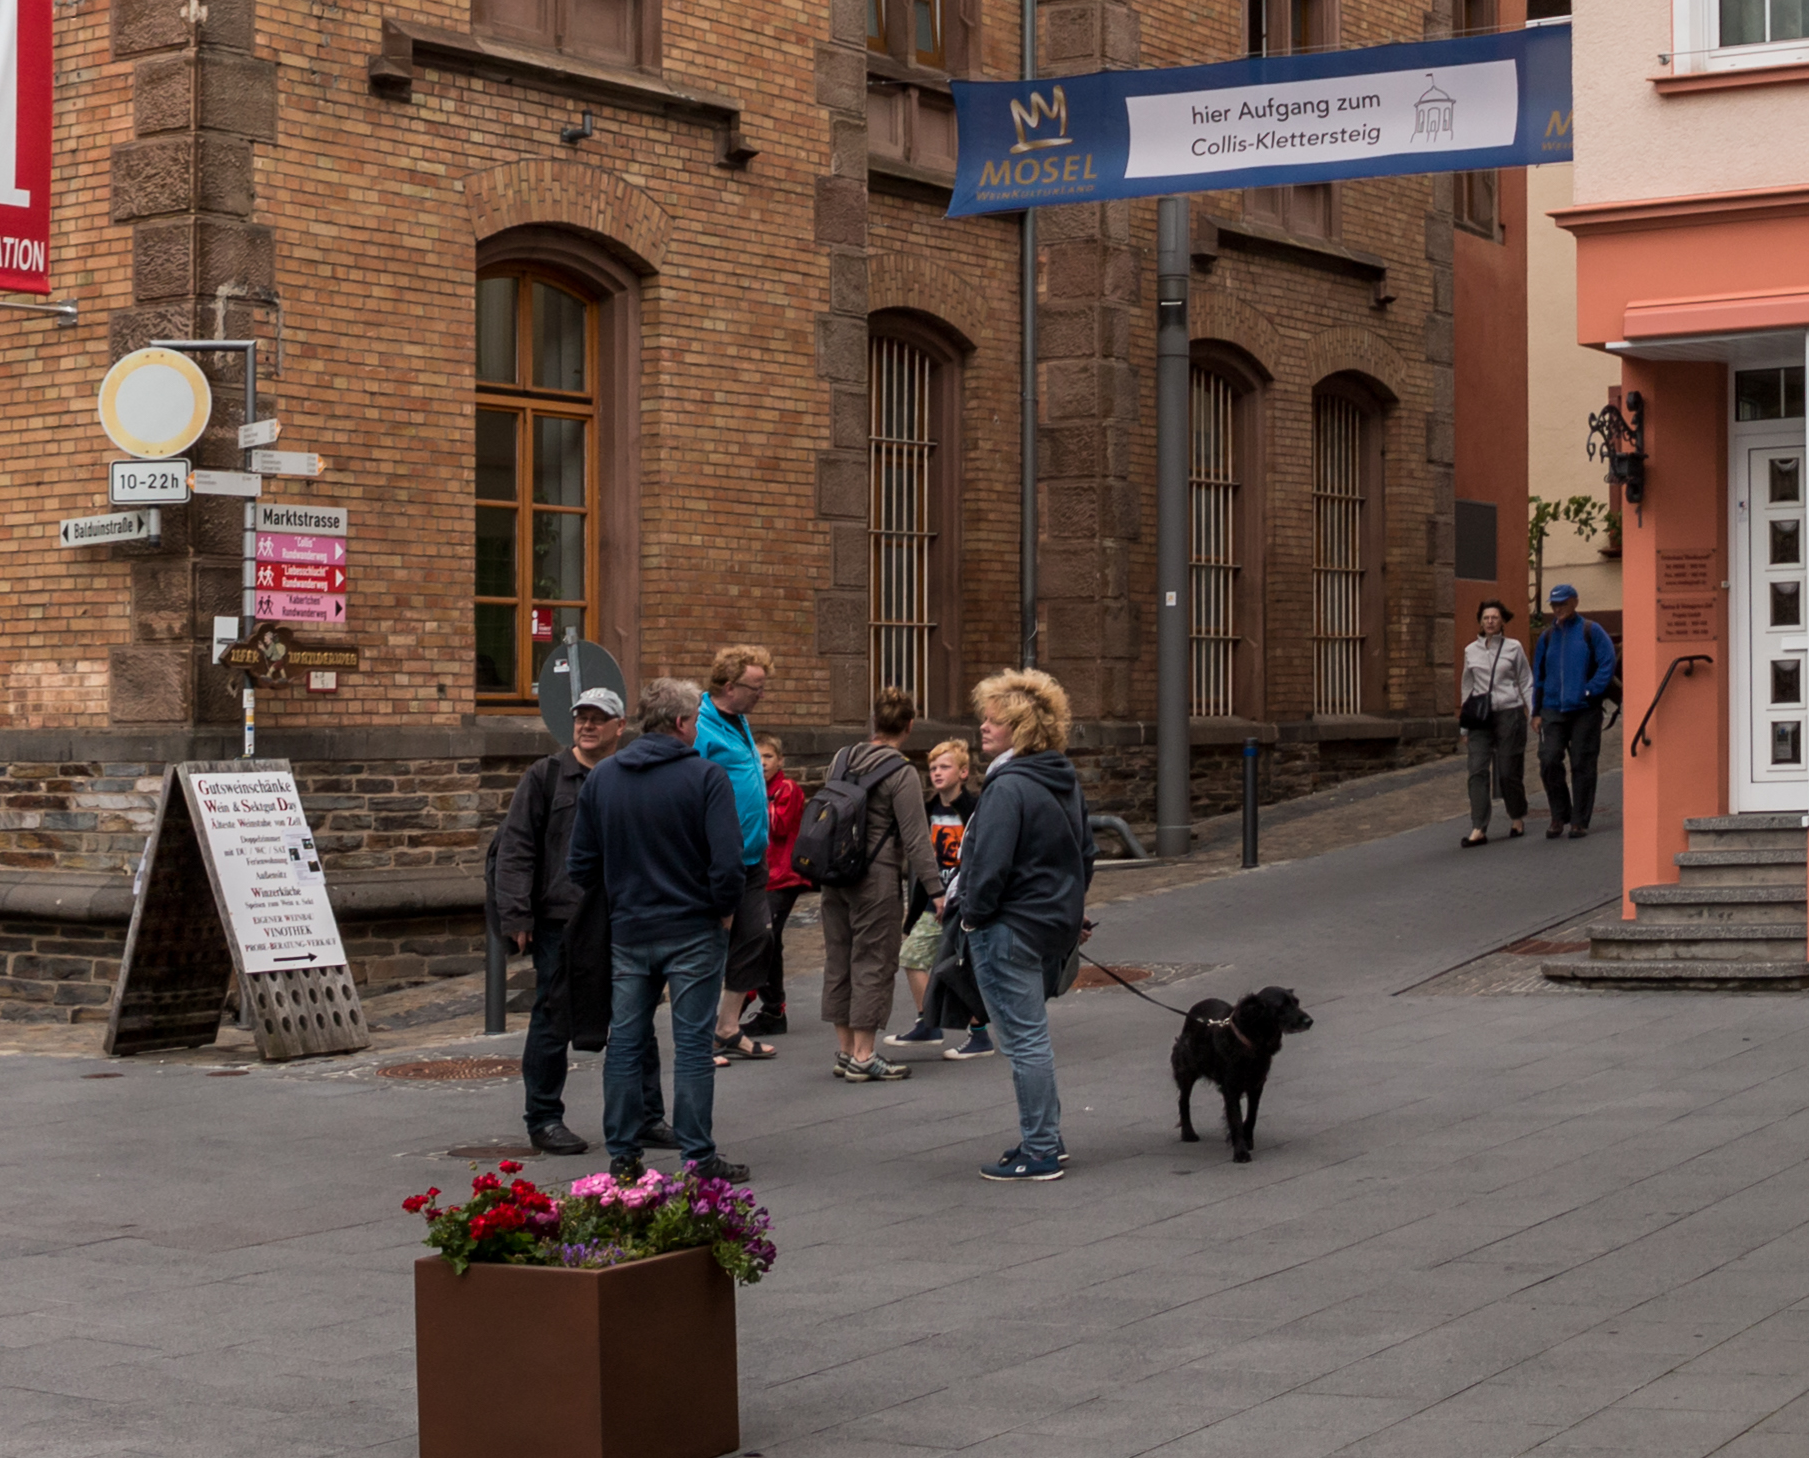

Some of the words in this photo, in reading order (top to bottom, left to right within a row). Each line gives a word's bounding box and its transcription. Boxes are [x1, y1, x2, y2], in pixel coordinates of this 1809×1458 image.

[1192, 106, 1231, 124] hier
[1238, 98, 1329, 122] Aufgang
[1337, 94, 1380, 111] zum
[1191, 123, 1381, 156] Collis-Klettersteig
[979, 154, 1097, 186] MOSEL
[263, 509, 340, 528] Marktstrasse
[74, 517, 132, 539] Balduinstraße
[282, 549, 327, 563] Rundwanderweg
[282, 577, 328, 591] Rundwanderweg
[282, 607, 327, 620] Rundwanderweg
[198, 779, 292, 795] Gutsweinschänke
[204, 800, 230, 813] Wein
[233, 802, 240, 812] &
[241, 800, 276, 813] Sektgut
[287, 817, 301, 826] Zell
[251, 886, 301, 898] Winzerküche
[263, 925, 312, 937] VINOTHEK
